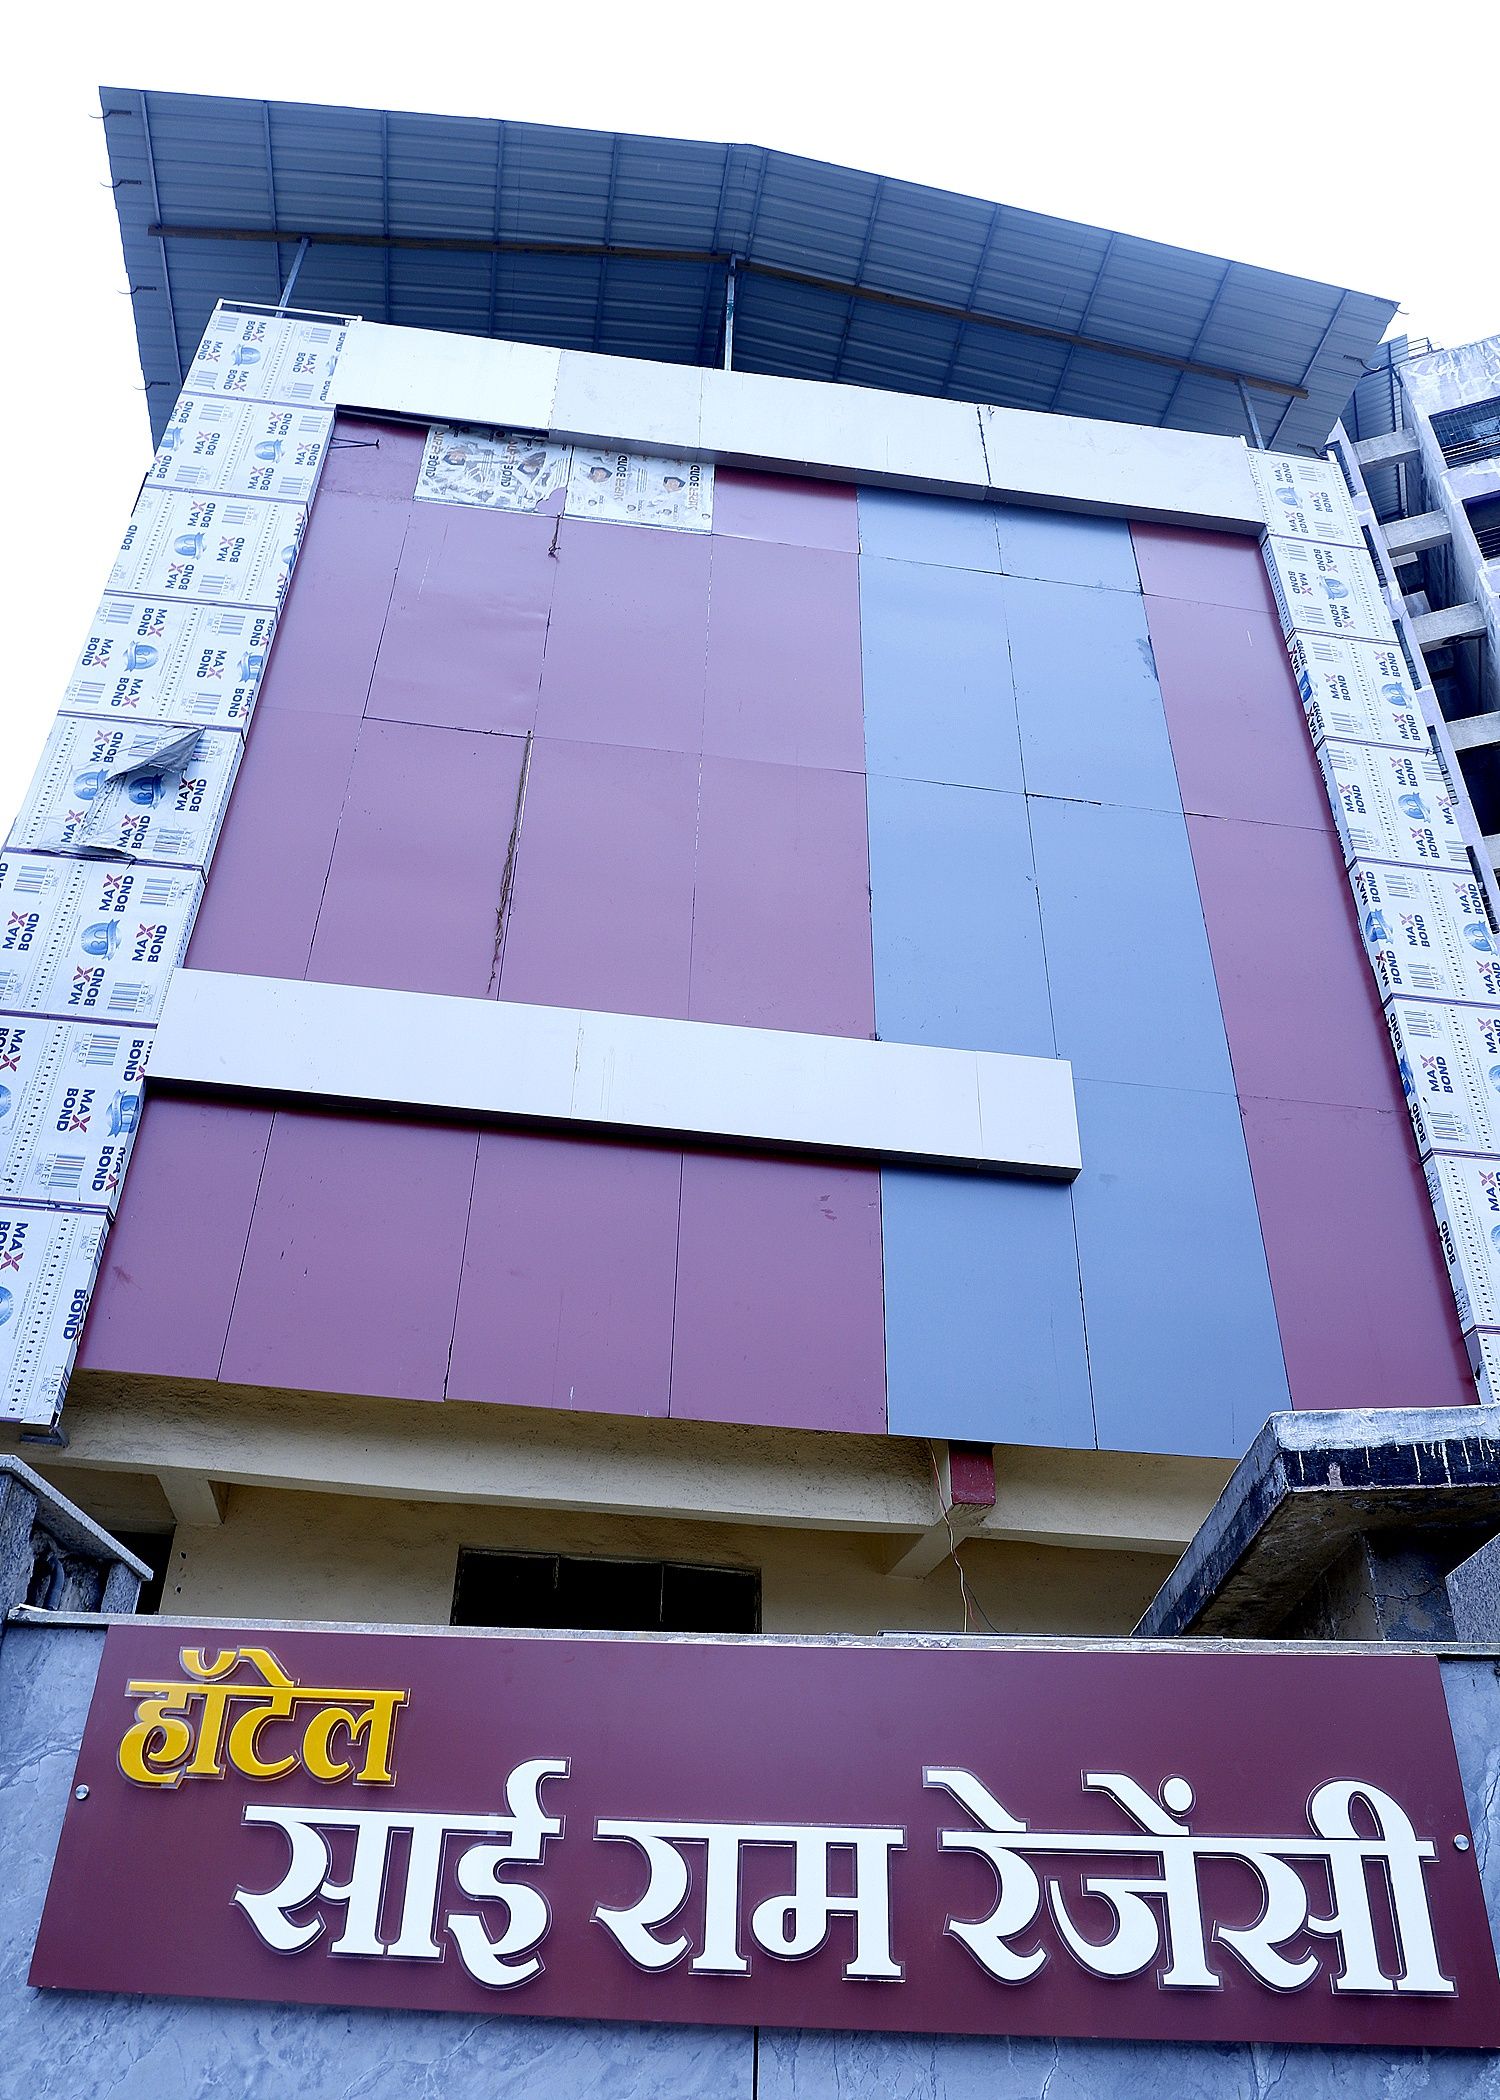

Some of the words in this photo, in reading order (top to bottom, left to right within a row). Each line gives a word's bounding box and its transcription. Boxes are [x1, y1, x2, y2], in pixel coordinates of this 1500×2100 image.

[179, 401, 194, 423] BOND
[267, 411, 284, 435] MAX
[278, 412, 293, 436] BOND
[193, 431, 212, 454] MAX
[206, 433, 221, 456] BOND
[295, 442, 311, 465] MAX
[307, 443, 321, 466] BOND
[157, 455, 172, 479] BOND
[248, 466, 265, 489] MAX
[260, 467, 275, 491] BOND
[188, 500, 207, 527] MAX
[200, 502, 216, 528] BOND
[1321, 492, 1333, 513] BOND
[121, 524, 137, 550] BOND
[1297, 512, 1309, 534] BOND
[217, 536, 235, 562] MAX
[230, 537, 245, 563] BOND
[1314, 548, 1326, 572] BOND
[1324, 550, 1338, 573] MAX
[165, 563, 185, 589] MAX
[179, 564, 195, 590] BOND
[1288, 570, 1300, 594] BOND
[1298, 572, 1313, 596] MAX
[137, 607, 154, 636] BOND
[147, 609, 168, 638] MAX
[1329, 604, 1342, 628] BOND
[1340, 605, 1356, 629] MAX
[249, 618, 265, 647] BOND
[81, 637, 100, 666] BOND
[92, 638, 114, 669] MAX
[196, 648, 213, 678] BOND
[207, 650, 227, 680] MAX
[1373, 651, 1390, 676] MAX
[1387, 652, 1400, 677] BOND
[111, 677, 129, 708] BOND
[121, 678, 144, 709] MAX
[1324, 673, 1340, 700] MAX
[1338, 675, 1351, 701] BOND
[228, 688, 245, 718] BOND
[1392, 713, 1409, 740] MAX
[1406, 714, 1420, 740] BOND
[90, 730, 113, 762] MAX
[104, 731, 124, 763] BOND
[1390, 757, 1407, 785] MAX
[1404, 759, 1418, 787] BOND
[175, 777, 197, 812] MAX
[189, 778, 207, 812] BOND
[1338, 782, 1355, 812] MAX
[1352, 785, 1367, 814] BOND
[1436, 796, 1454, 825] MAX
[61, 809, 84, 843] MAX
[117, 814, 141, 847] MAX
[131, 815, 151, 849] BOND
[1409, 827, 1428, 857] MAX
[1424, 828, 1440, 859] BOND
[99, 874, 123, 911] MAX
[114, 875, 134, 913] BOND
[1366, 871, 1380, 903] BOND
[1452, 882, 1472, 913] MAX
[1468, 883, 1483, 915] BOND
[3, 911, 28, 950] MAX
[18, 913, 40, 951] BOND
[132, 923, 156, 962] MAX
[148, 924, 167, 963] BOND
[1399, 912, 1418, 946] MAX
[1414, 914, 1430, 948] BOND
[1386, 950, 1402, 984] BOND
[1476, 960, 1496, 994] MAX
[68, 966, 94, 1005] MAX
[84, 967, 105, 1007] BOND
[1390, 1012, 1403, 1051] BOND
[1477, 1017, 1498, 1054] MAX
[0, 1029, 25, 1072] MAX
[123, 1039, 144, 1081] BOND
[1420, 1054, 1440, 1092] MAX
[1436, 1056, 1454, 1094] BOND
[56, 1088, 79, 1132] BOND
[69, 1089, 95, 1133] MAX
[1411, 1102, 1427, 1144] BOND
[91, 1146, 114, 1191] BOND
[1478, 1170, 1500, 1212] MAX
[0, 1222, 29, 1272] MAX
[85, 1226, 101, 1261] TIMEX
[1441, 1221, 1457, 1265] BOND
[63, 1289, 87, 1340] BOND
[45, 1365, 63, 1404] TIMEX
[118, 1647, 406, 1784] हॉटेल
[233, 1758, 568, 1986] साई
[595, 1818, 906, 1977] राम
[924, 1767, 1456, 1993] रेजेंसी
